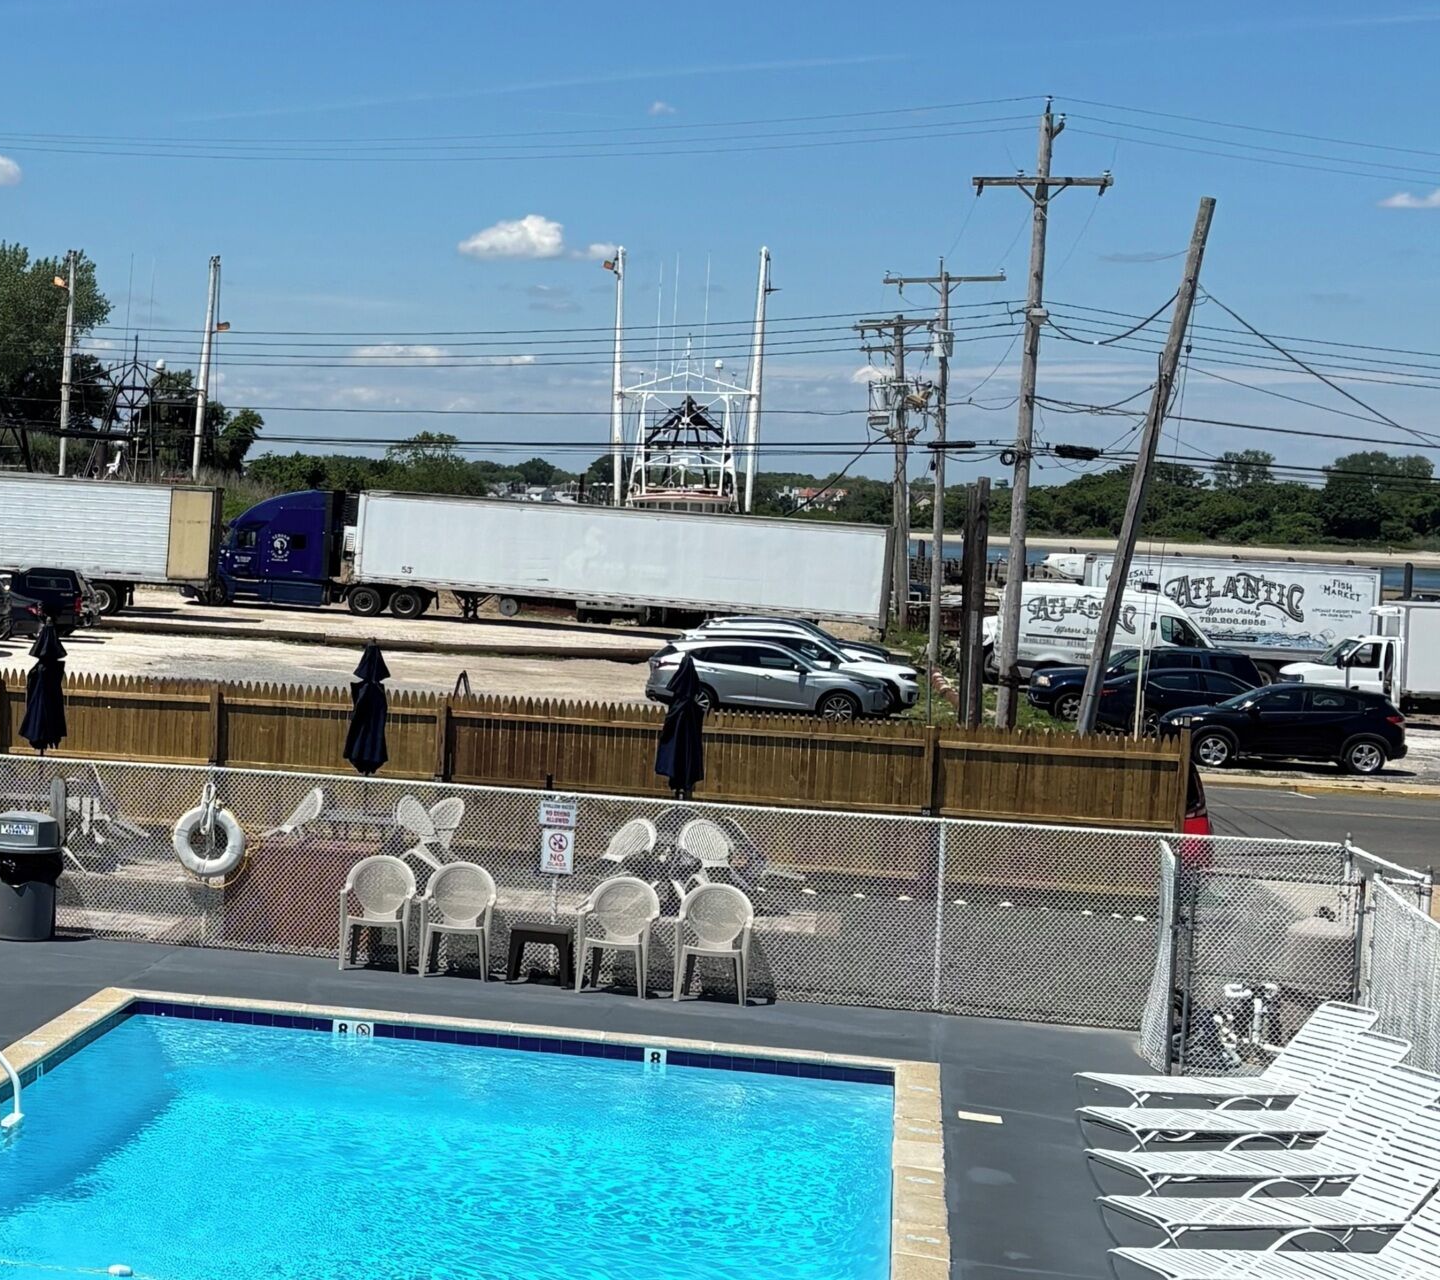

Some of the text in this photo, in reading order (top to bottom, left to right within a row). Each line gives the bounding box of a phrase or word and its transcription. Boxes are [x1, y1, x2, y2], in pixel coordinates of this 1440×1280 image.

[1332, 579, 1353, 592] FISH
[1164, 572, 1304, 622] ATLANTIC
[1323, 585, 1362, 602] MARKET
[550, 853, 565, 862] NO
[650, 1051, 661, 1063] 8
